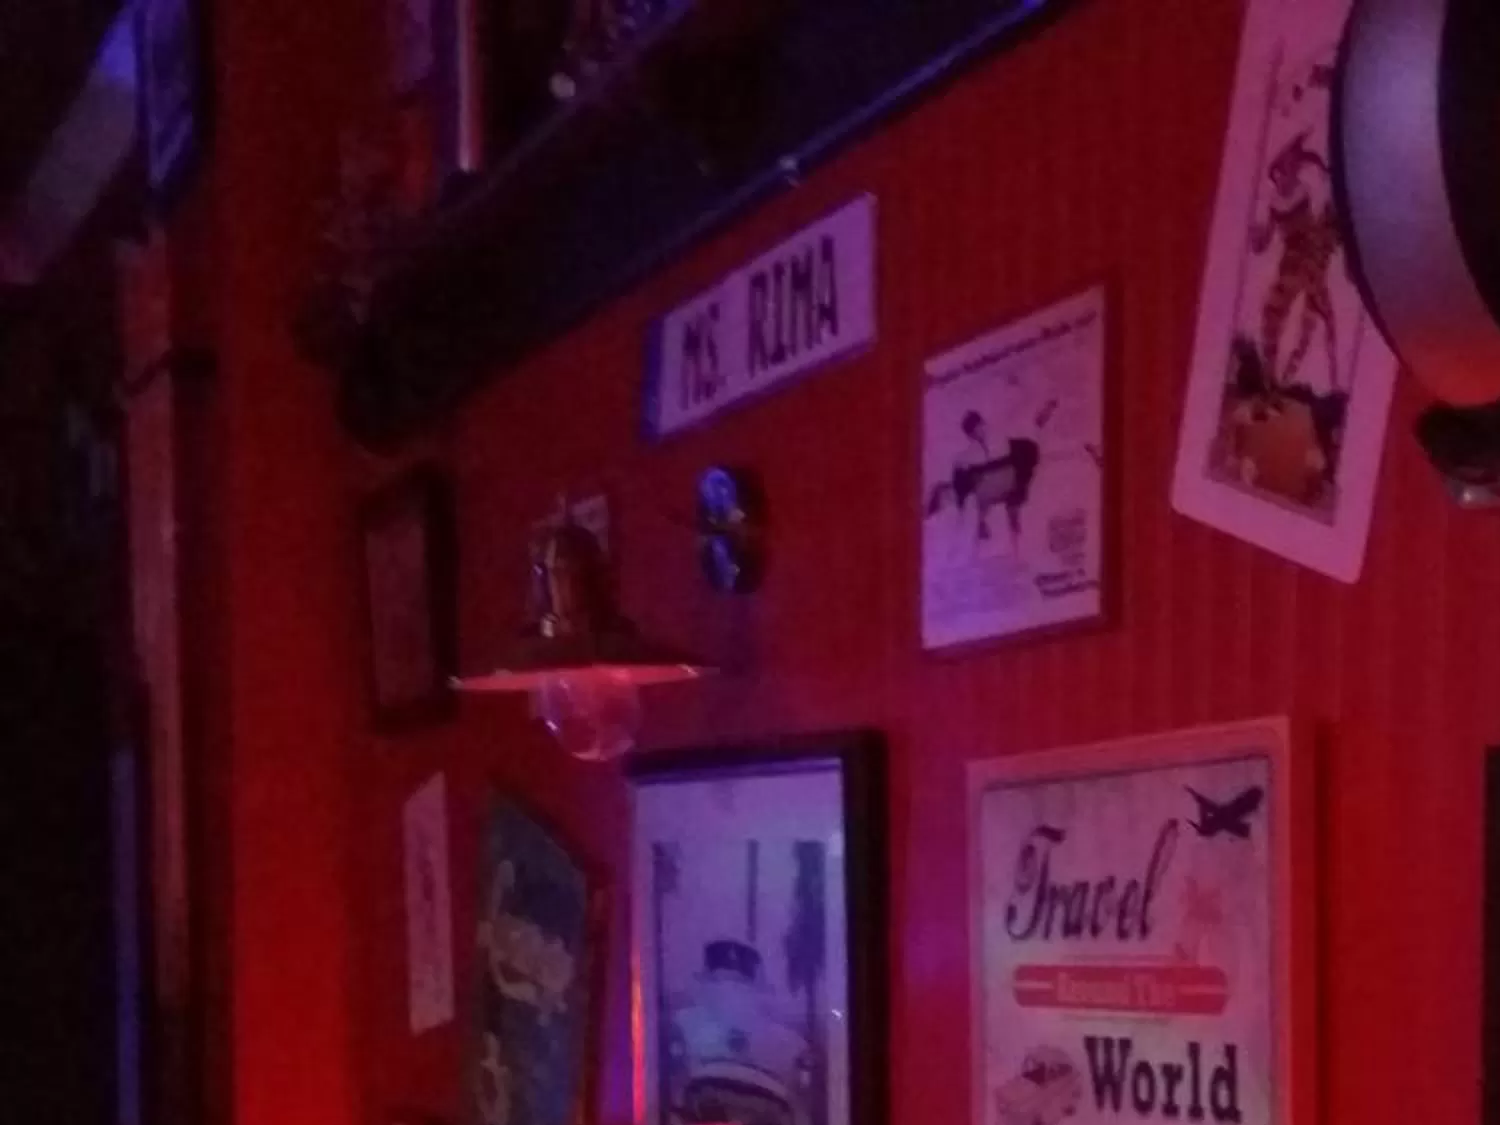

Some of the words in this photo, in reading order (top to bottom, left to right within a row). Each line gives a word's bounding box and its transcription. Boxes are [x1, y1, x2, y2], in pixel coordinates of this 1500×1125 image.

[748, 234, 840, 381] RIMA
[1004, 819, 1180, 943] Travel
[1083, 1034, 1243, 1125] World
